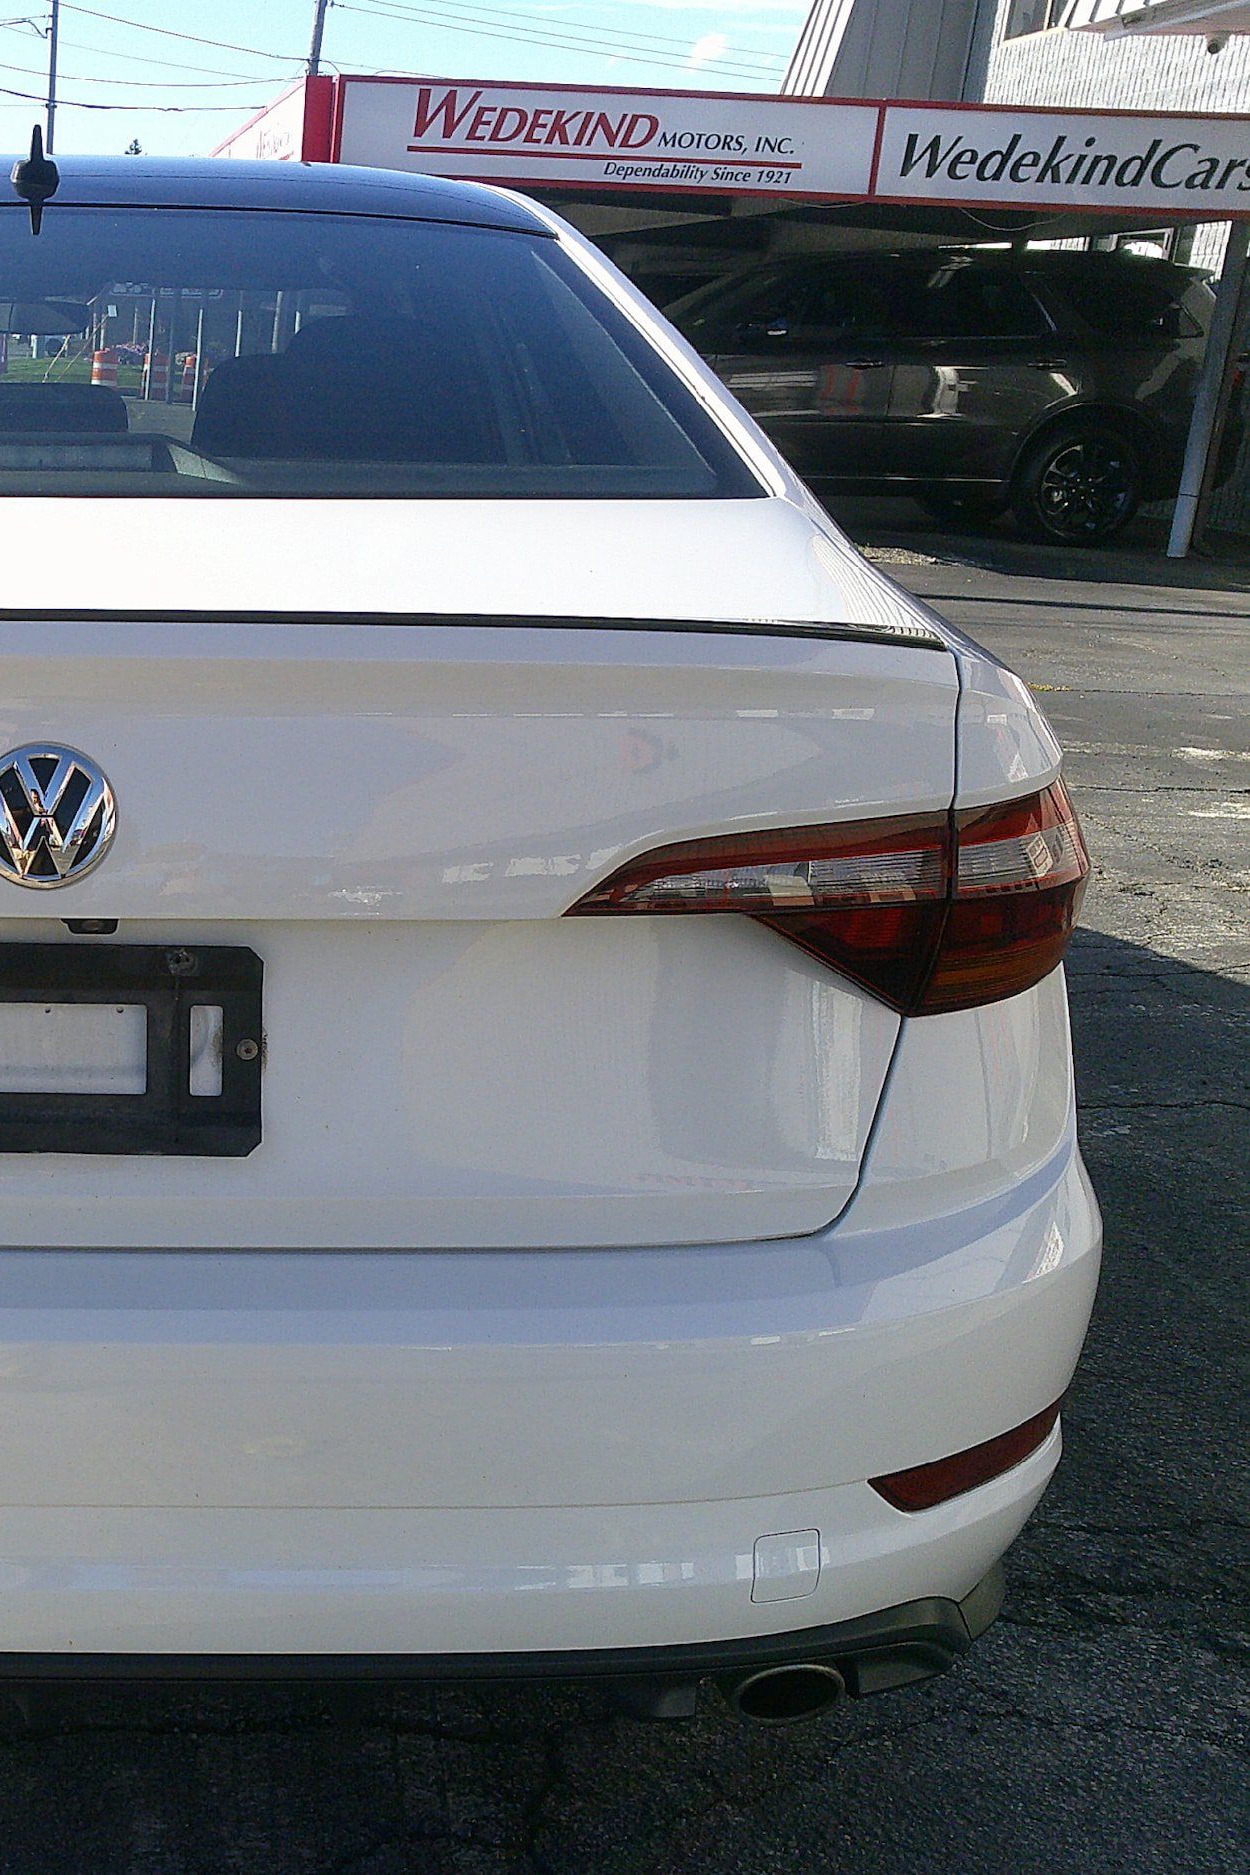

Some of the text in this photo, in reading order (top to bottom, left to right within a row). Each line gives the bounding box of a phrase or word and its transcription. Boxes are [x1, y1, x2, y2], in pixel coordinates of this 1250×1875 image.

[414, 88, 795, 155] WEDEKIND MOTORS, INC.
[604, 162, 791, 184] Dependability Since 1921
